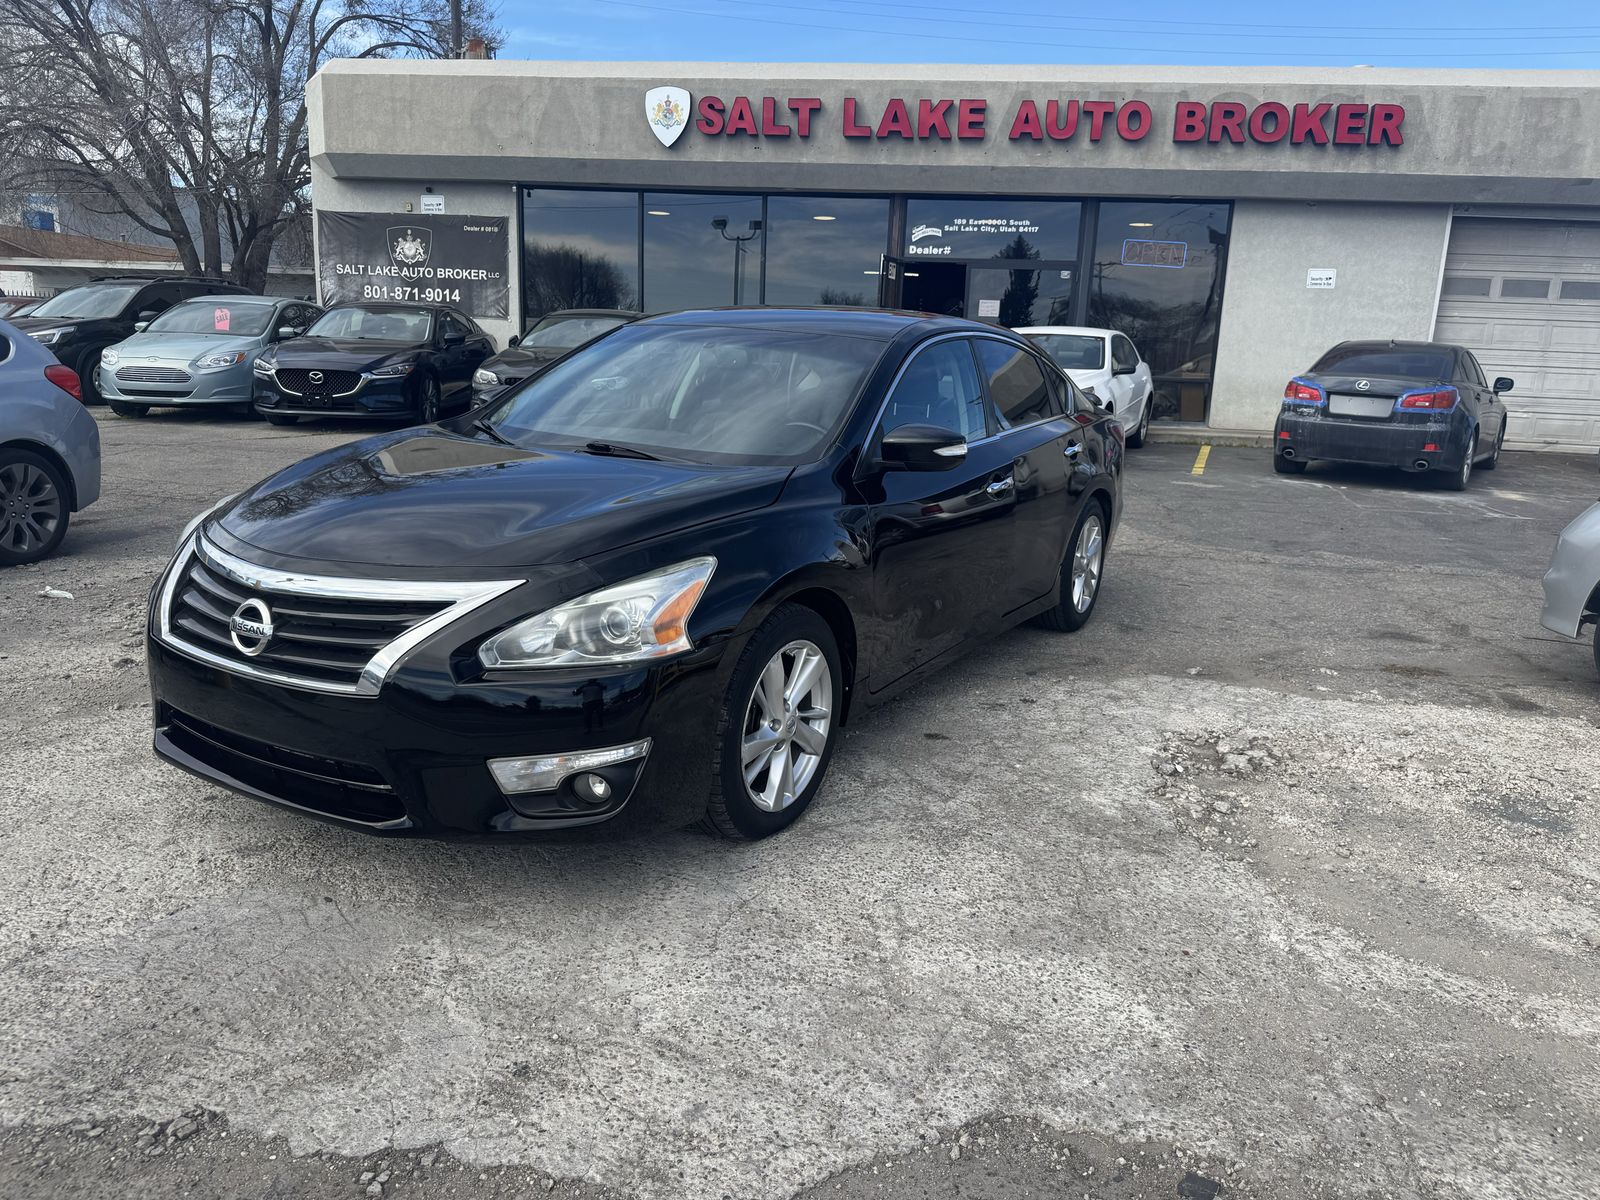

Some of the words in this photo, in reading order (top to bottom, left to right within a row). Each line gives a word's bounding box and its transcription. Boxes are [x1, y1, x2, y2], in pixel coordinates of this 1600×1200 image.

[696, 96, 821, 138] SALT
[843, 97, 987, 140] LAKE
[1008, 99, 1153, 142] AUTO
[1172, 101, 1406, 145] BROKER
[980, 226, 998, 234] City,
[909, 245, 952, 255] Dealer#
[336, 263, 365, 275] SALT
[367, 264, 399, 277] LAKE
[401, 266, 434, 278] AUTO
[437, 267, 488, 280] BROKER
[364, 284, 461, 303] 801-871-9014
